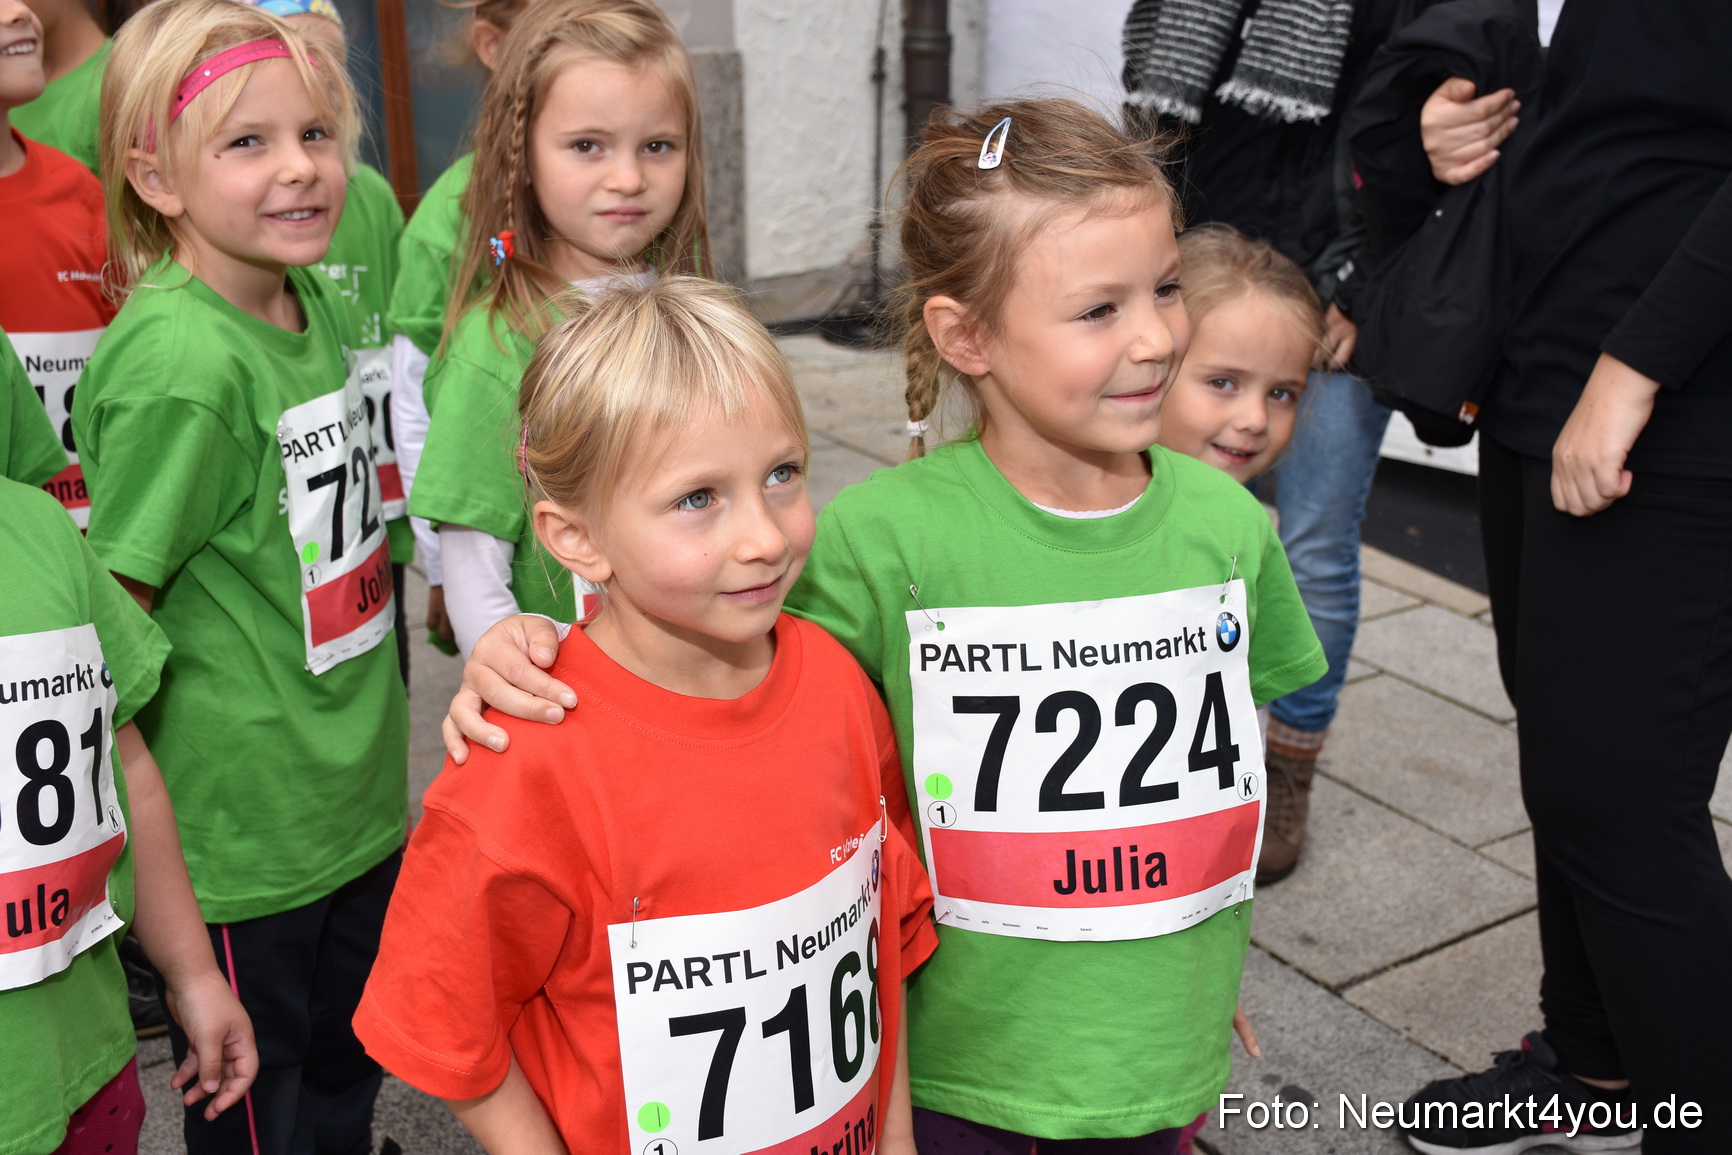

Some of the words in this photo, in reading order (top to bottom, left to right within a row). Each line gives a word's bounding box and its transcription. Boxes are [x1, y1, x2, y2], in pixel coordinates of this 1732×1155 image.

[281, 420, 348, 464] PARTL
[306, 446, 380, 562] 72
[920, 643, 1042, 673] PARTL
[1052, 626, 1207, 670] Neumarkt
[952, 671, 1241, 813] 7224
[1243, 776, 1252, 797] K
[108, 809, 119, 829] K
[936, 805, 946, 824] 1
[830, 845, 842, 865] FC
[1053, 844, 1168, 896] Julia
[6, 883, 69, 939] ula
[627, 949, 767, 995] PARTL
[776, 876, 872, 971] Neumarkt
